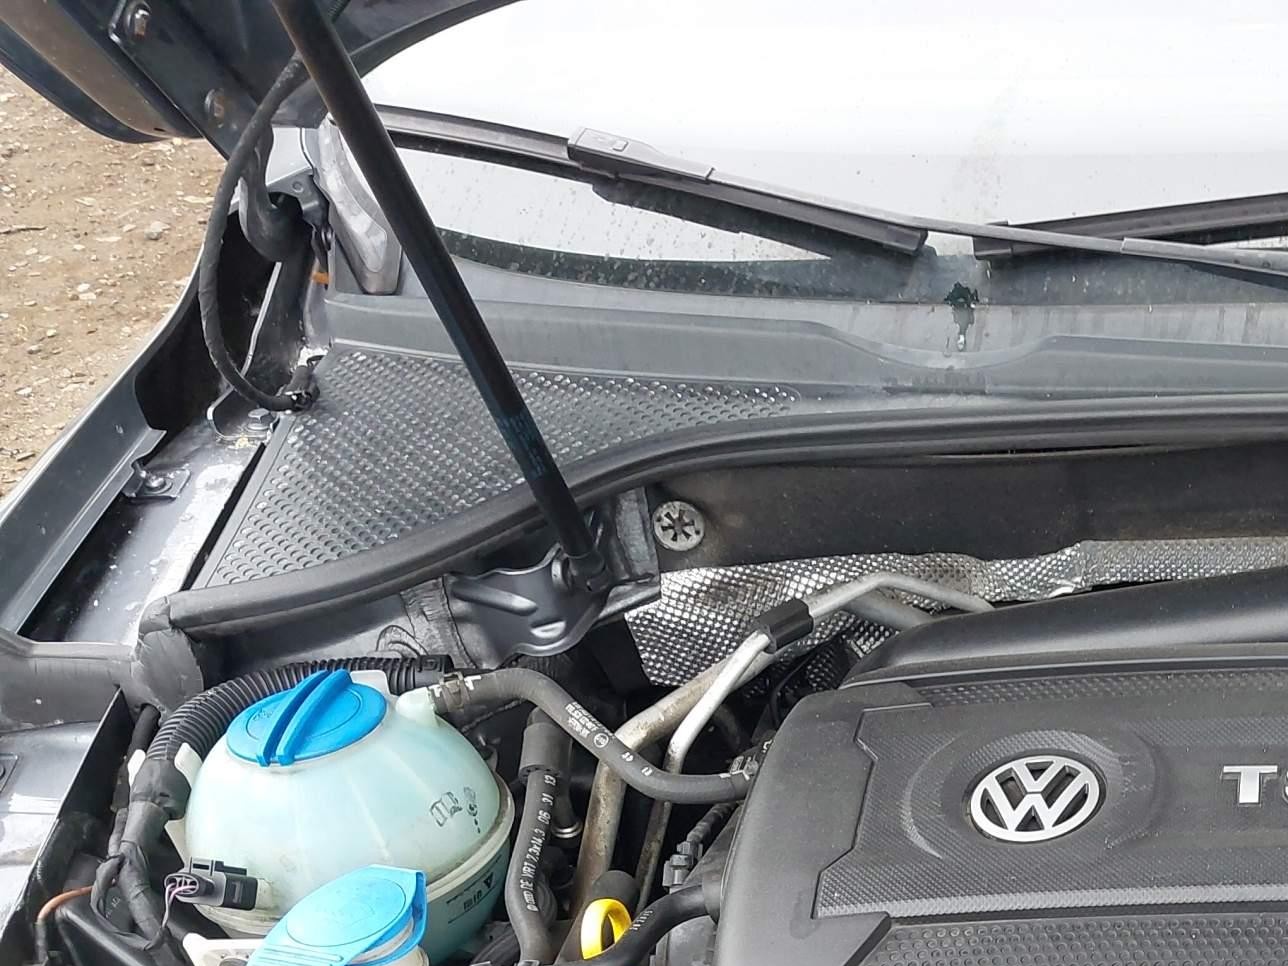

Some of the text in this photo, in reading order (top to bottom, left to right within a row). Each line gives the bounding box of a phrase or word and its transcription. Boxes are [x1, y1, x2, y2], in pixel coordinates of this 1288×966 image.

[544, 774, 556, 786] 13
[541, 792, 554, 806] 31
[537, 809, 551, 825] 06
